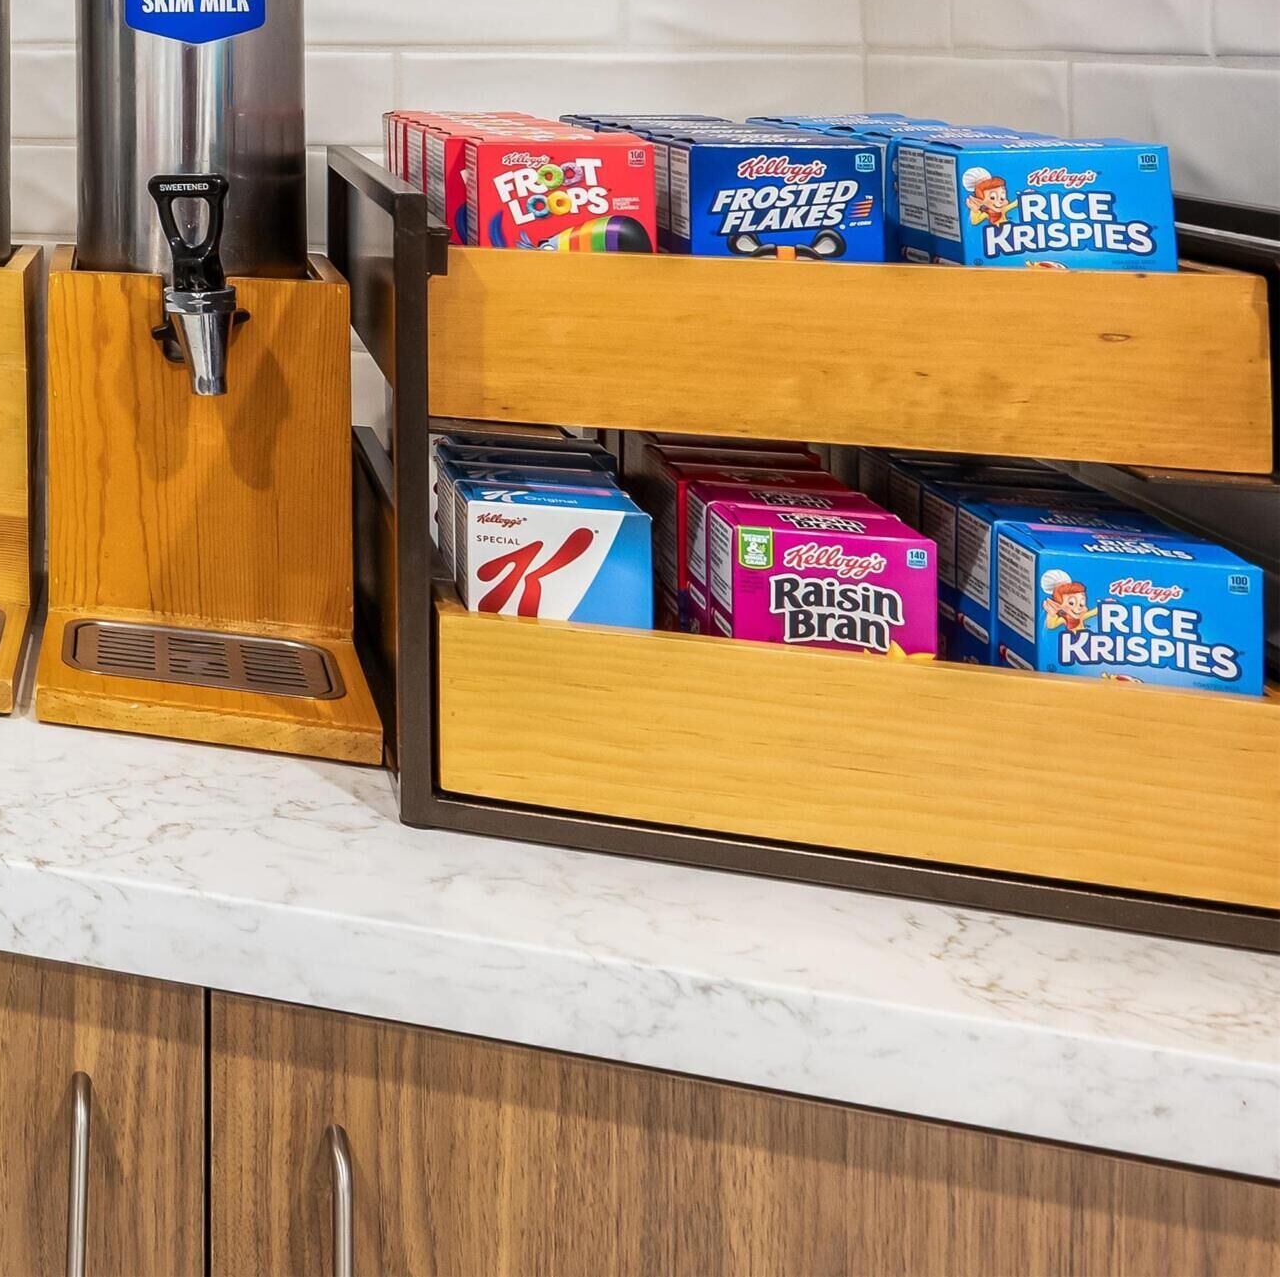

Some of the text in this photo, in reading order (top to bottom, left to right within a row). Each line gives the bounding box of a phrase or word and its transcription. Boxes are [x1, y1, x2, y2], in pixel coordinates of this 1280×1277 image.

[502, 152, 550, 168] Kellogg's
[630, 151, 644, 159] 100
[738, 155, 826, 183] Kellogg's
[858, 155, 873, 164] 120
[1140, 155, 1156, 164] 100
[159, 182, 209, 191] SWEETENED
[493, 158, 602, 203] FROOT
[1028, 167, 1097, 188] Kellogg's
[508, 187, 609, 225] LOOPS
[712, 180, 859, 212] FROSTED
[1020, 192, 1113, 222] RICE
[720, 203, 845, 234] FLAKES
[986, 222, 1153, 256] KRISPIES
[524, 495, 578, 505] Original
[476, 512, 523, 528] Kellogg's
[476, 534, 520, 545] SPECIAL
[784, 542, 886, 578] Kellogg's
[910, 551, 925, 560] 140
[477, 527, 594, 618] K
[1231, 576, 1247, 586] 100
[771, 576, 902, 623] Raisin
[1110, 577, 1183, 603] Kellogg's
[787, 609, 888, 649] Bran
[1101, 603, 1197, 641] RICE
[1061, 632, 1238, 678] KRISPIES
